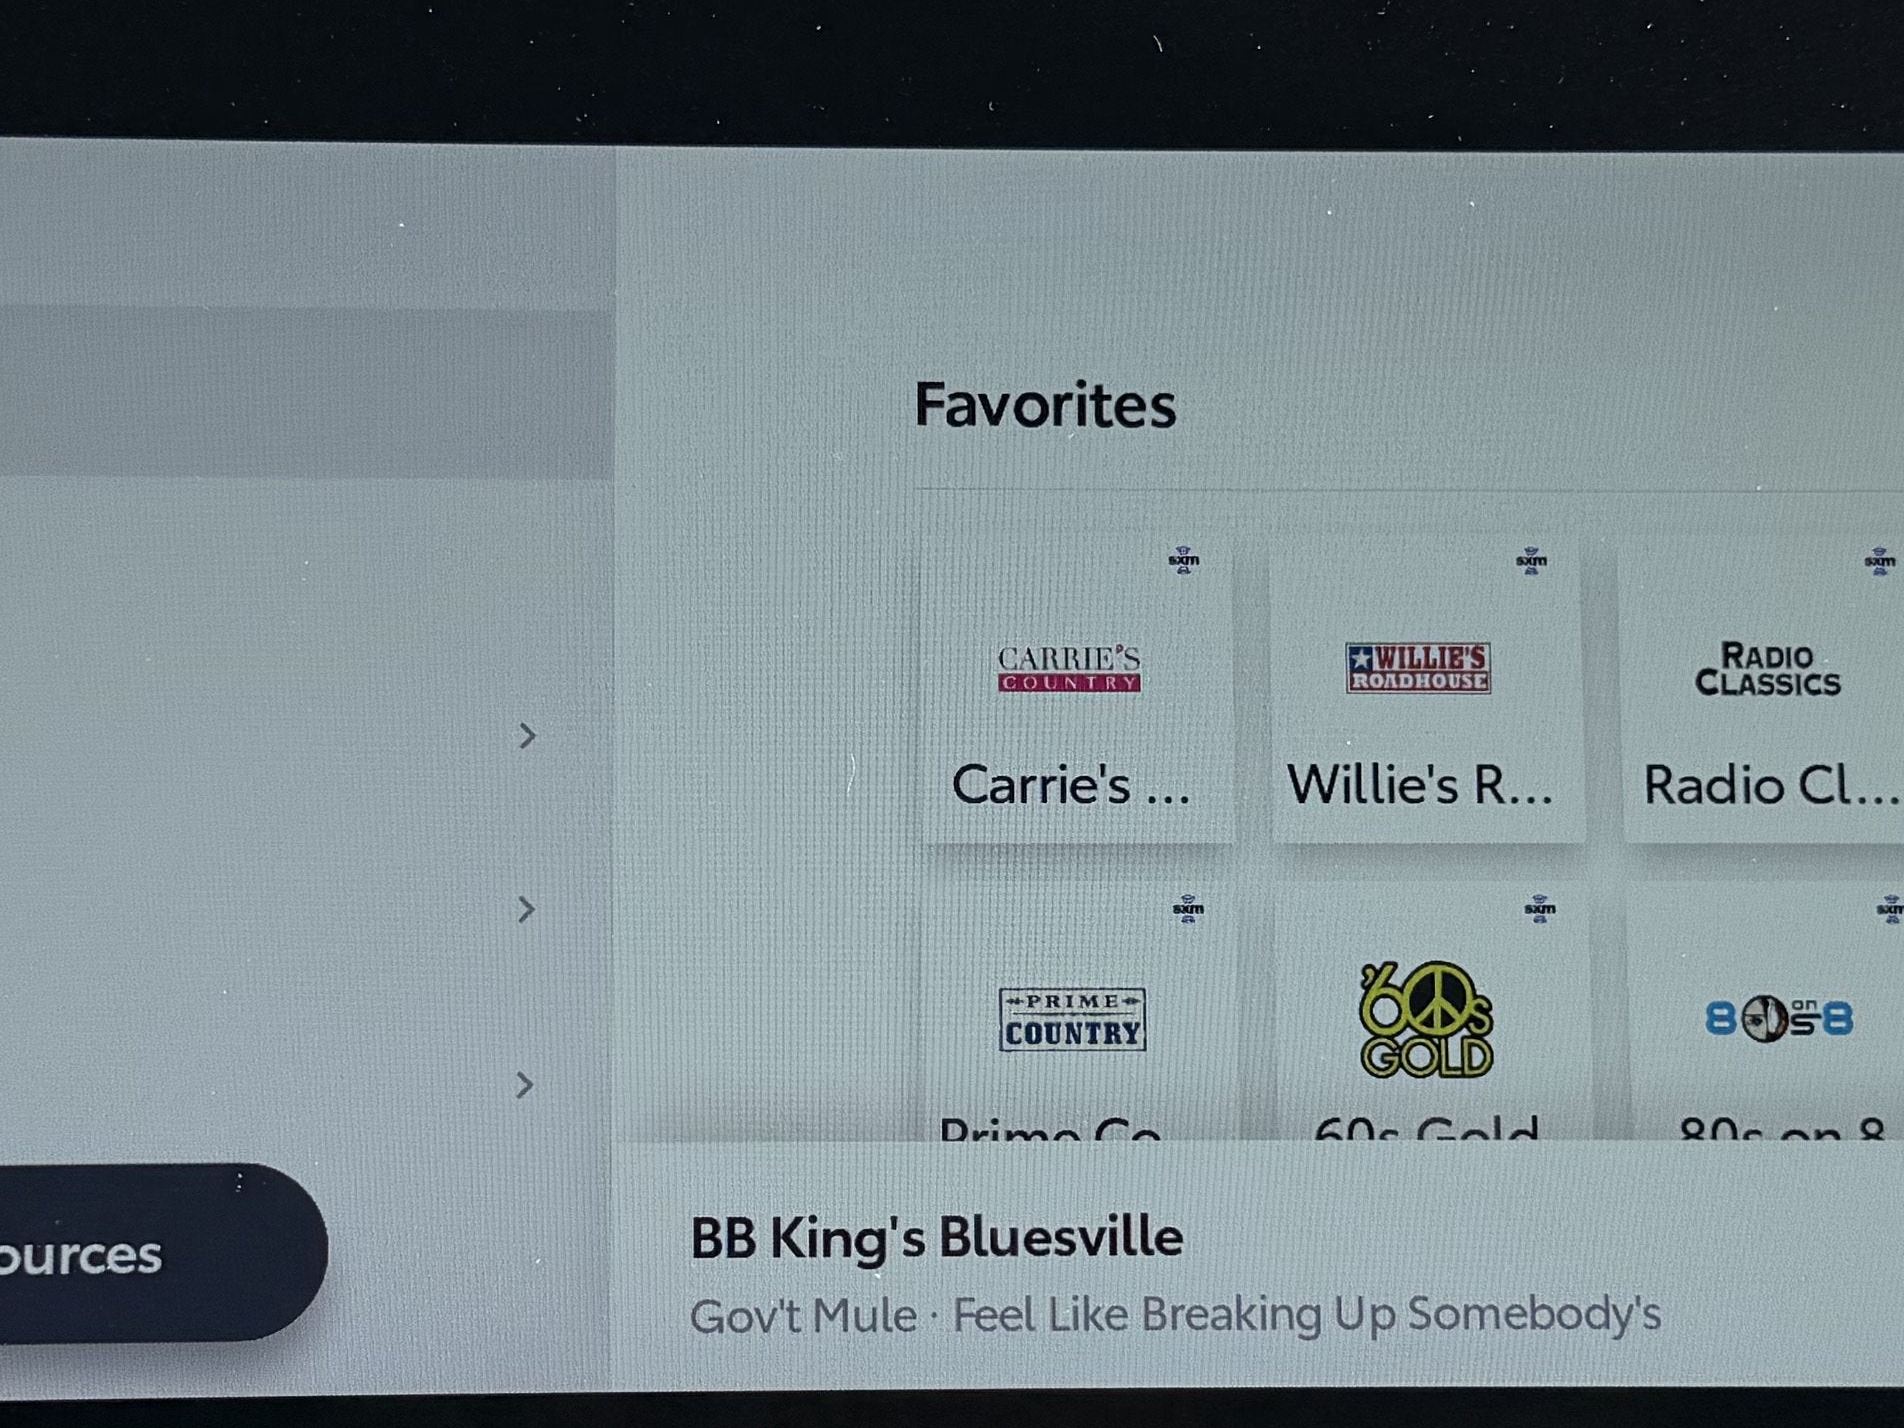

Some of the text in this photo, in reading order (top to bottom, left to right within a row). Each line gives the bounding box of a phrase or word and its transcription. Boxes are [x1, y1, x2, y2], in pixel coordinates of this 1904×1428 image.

[917, 379, 1176, 428] Favorites
[999, 644, 1141, 670] CARRIE'S
[1375, 645, 1486, 669] WILLIE'S
[1002, 675, 1137, 690] COUNTRY
[1352, 673, 1487, 689] ROADHOUSE
[953, 763, 1130, 804] Carrie's
[1288, 762, 1458, 804] Willie's
[1647, 763, 1784, 804] Radio
[1026, 994, 1119, 1009] PRIME
[1005, 1021, 1141, 1045] COUNTRY
[1360, 1035, 1494, 1079] GOLD
[693, 1213, 1183, 1270] BB King's Bluesville
[691, 1299, 801, 1334] Gov't
[815, 1296, 917, 1333] Mule
[956, 1295, 1036, 1332] Feel
[1051, 1295, 1128, 1331] Like
[1144, 1294, 1321, 1341] Breaking
[1336, 1296, 1396, 1341] Up
[1409, 1294, 1661, 1341] Somebody's
